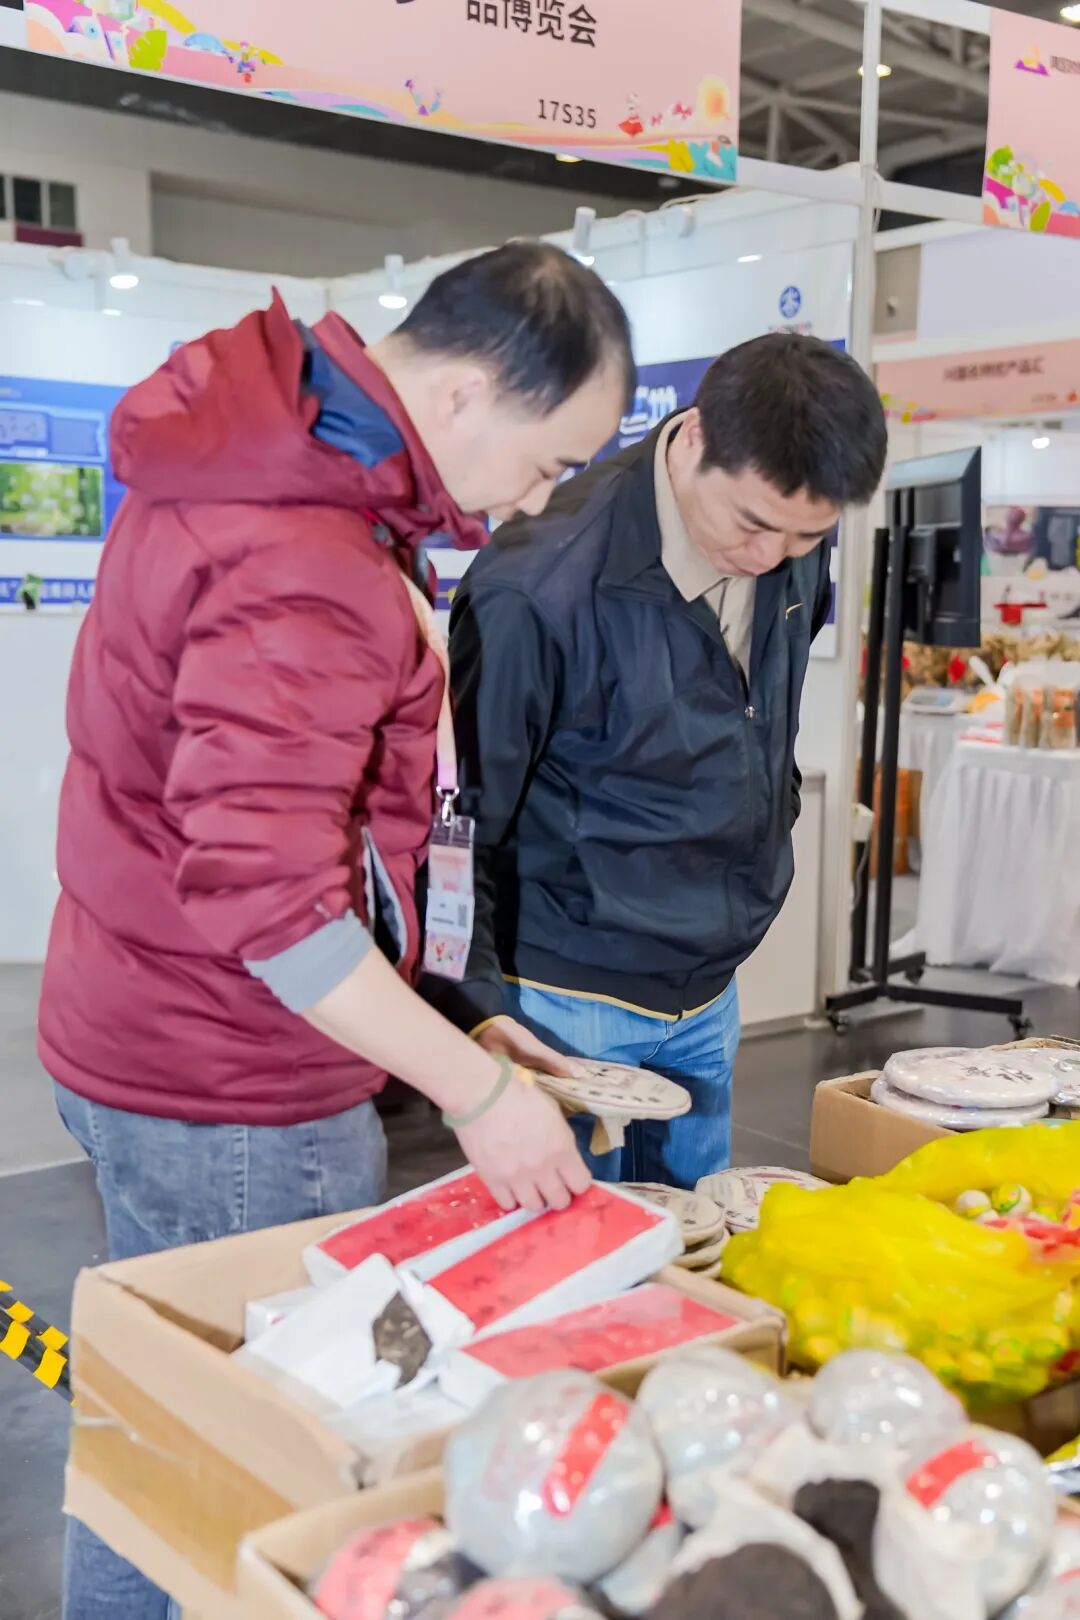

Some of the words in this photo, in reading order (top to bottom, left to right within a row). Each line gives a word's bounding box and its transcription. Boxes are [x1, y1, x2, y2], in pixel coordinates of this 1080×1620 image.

[467, 0, 597, 47] 品博览会
[538, 99, 596, 128] 17S35
